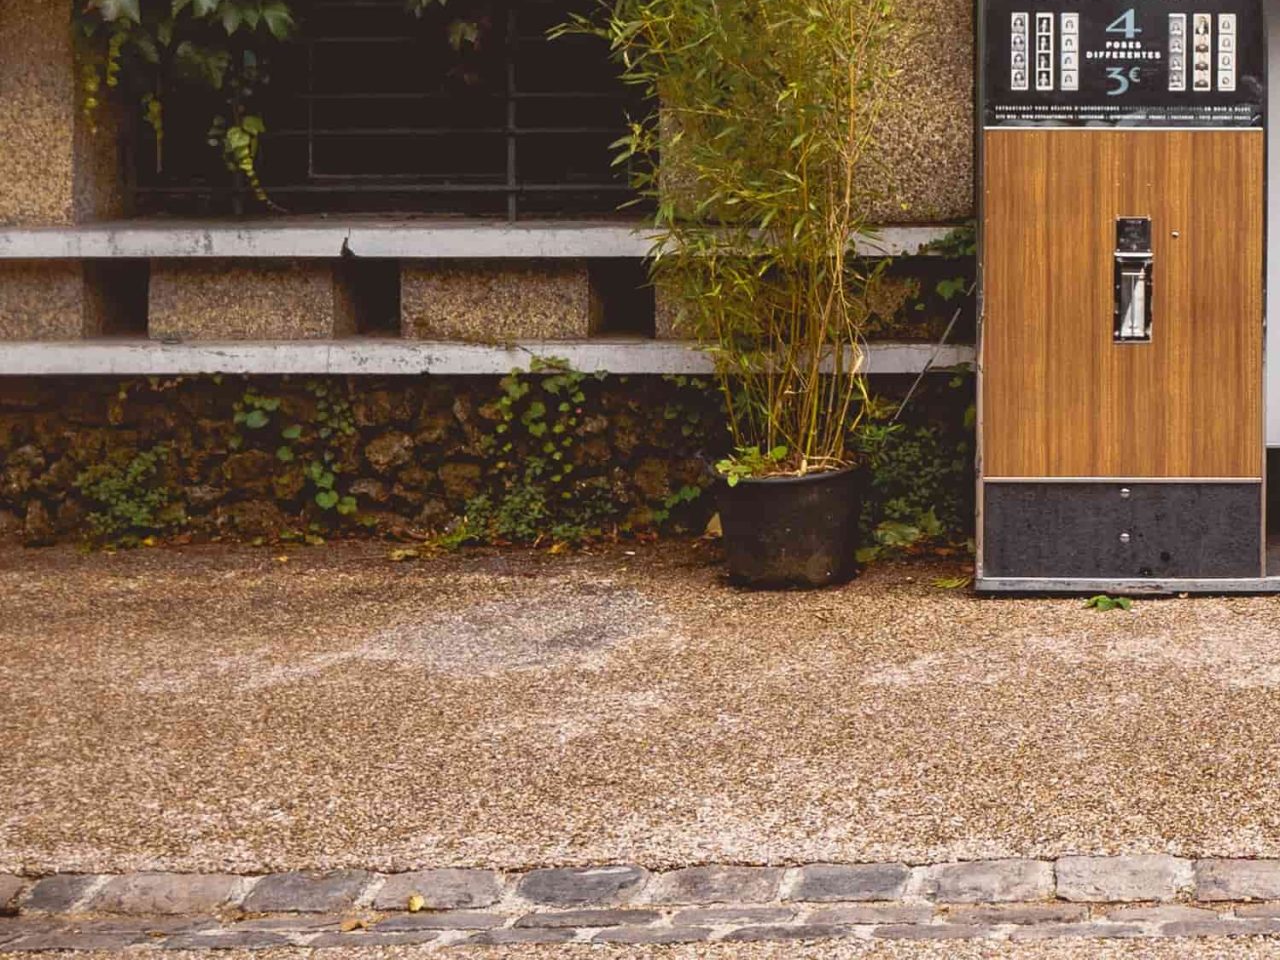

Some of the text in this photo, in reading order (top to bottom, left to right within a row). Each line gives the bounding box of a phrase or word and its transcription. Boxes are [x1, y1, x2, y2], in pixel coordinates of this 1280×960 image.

[1105, 8, 1143, 39] 4
[1105, 41, 1142, 50] POSES
[1085, 51, 1162, 60] DIFFERENTES
[1105, 66, 1142, 96] 3€
